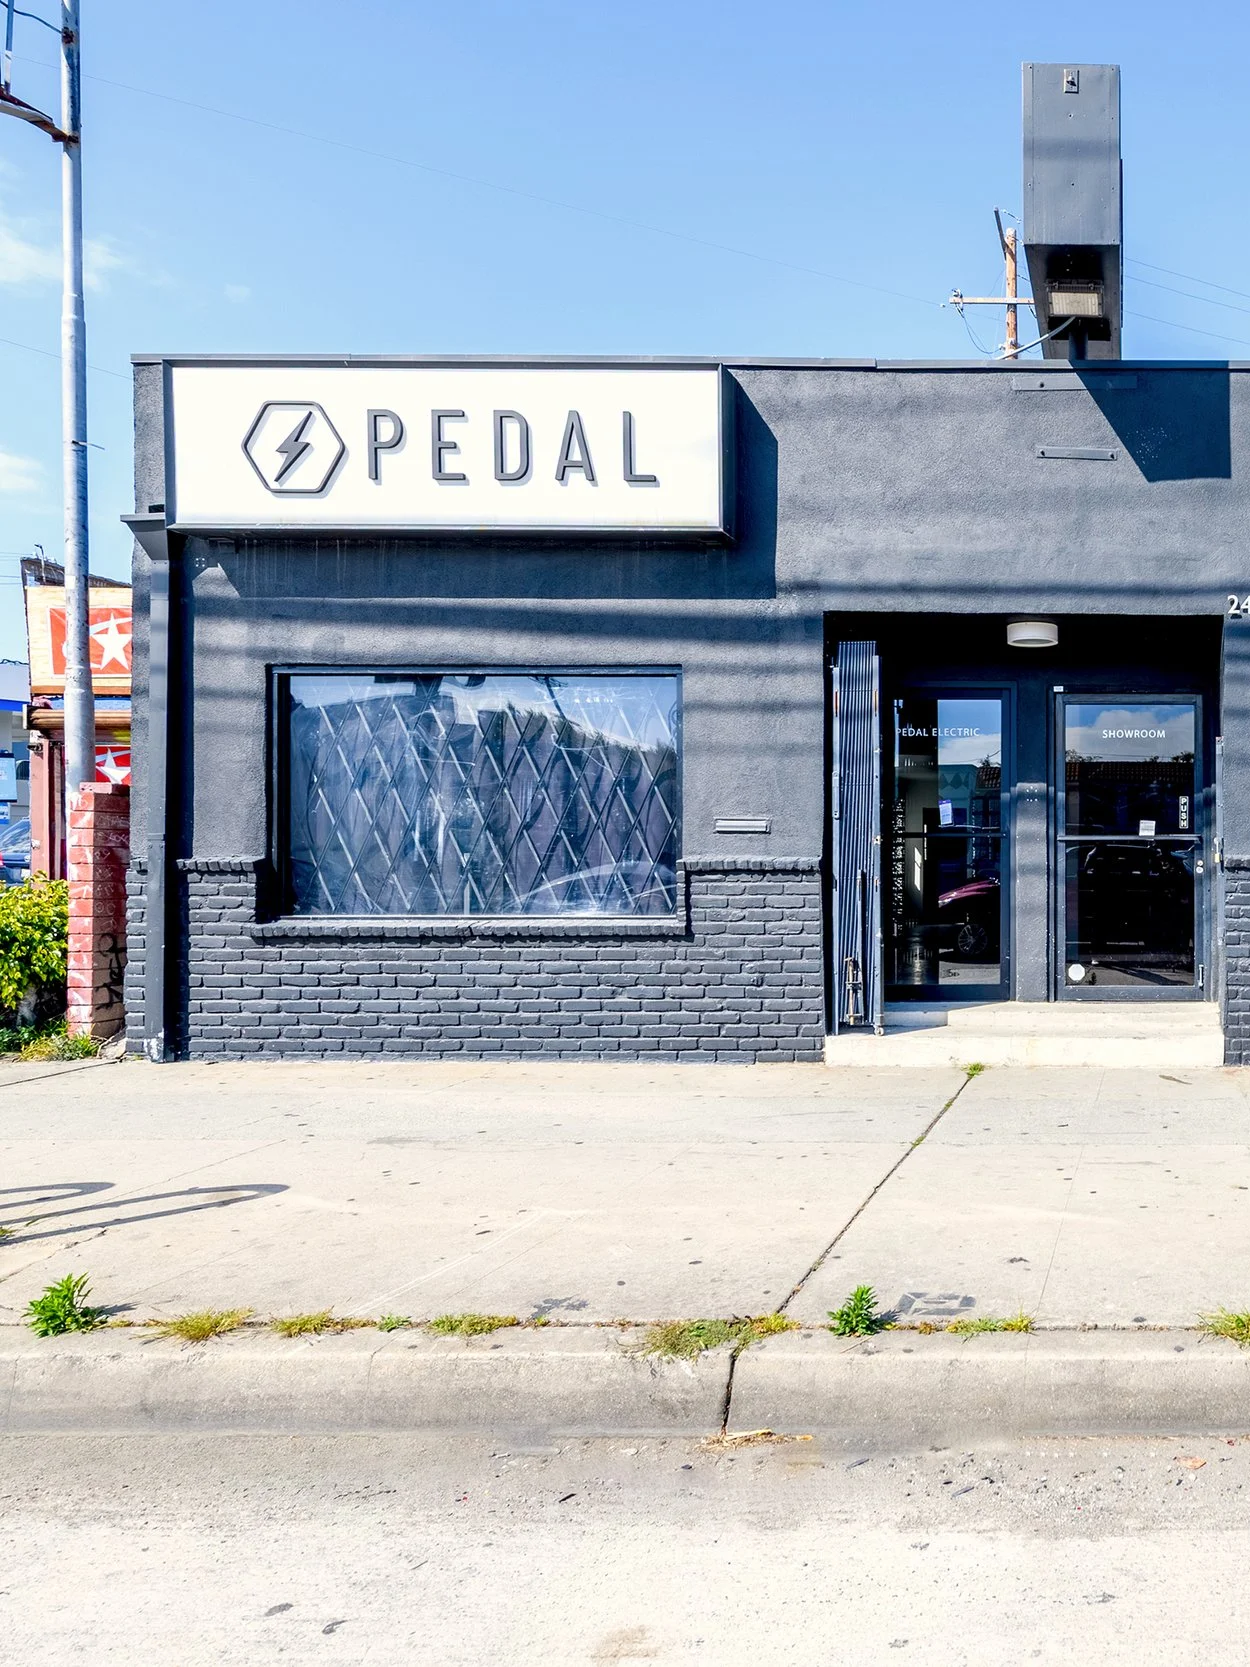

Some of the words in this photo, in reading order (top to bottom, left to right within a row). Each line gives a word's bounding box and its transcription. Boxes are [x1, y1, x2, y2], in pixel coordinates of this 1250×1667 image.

[366, 408, 659, 484] PEDAL
[895, 727, 929, 737] PEDAL
[932, 727, 980, 737] ELECTRIC
[1102, 729, 1166, 739] SHOWROOM
[1180, 797, 1188, 828] PUSH
